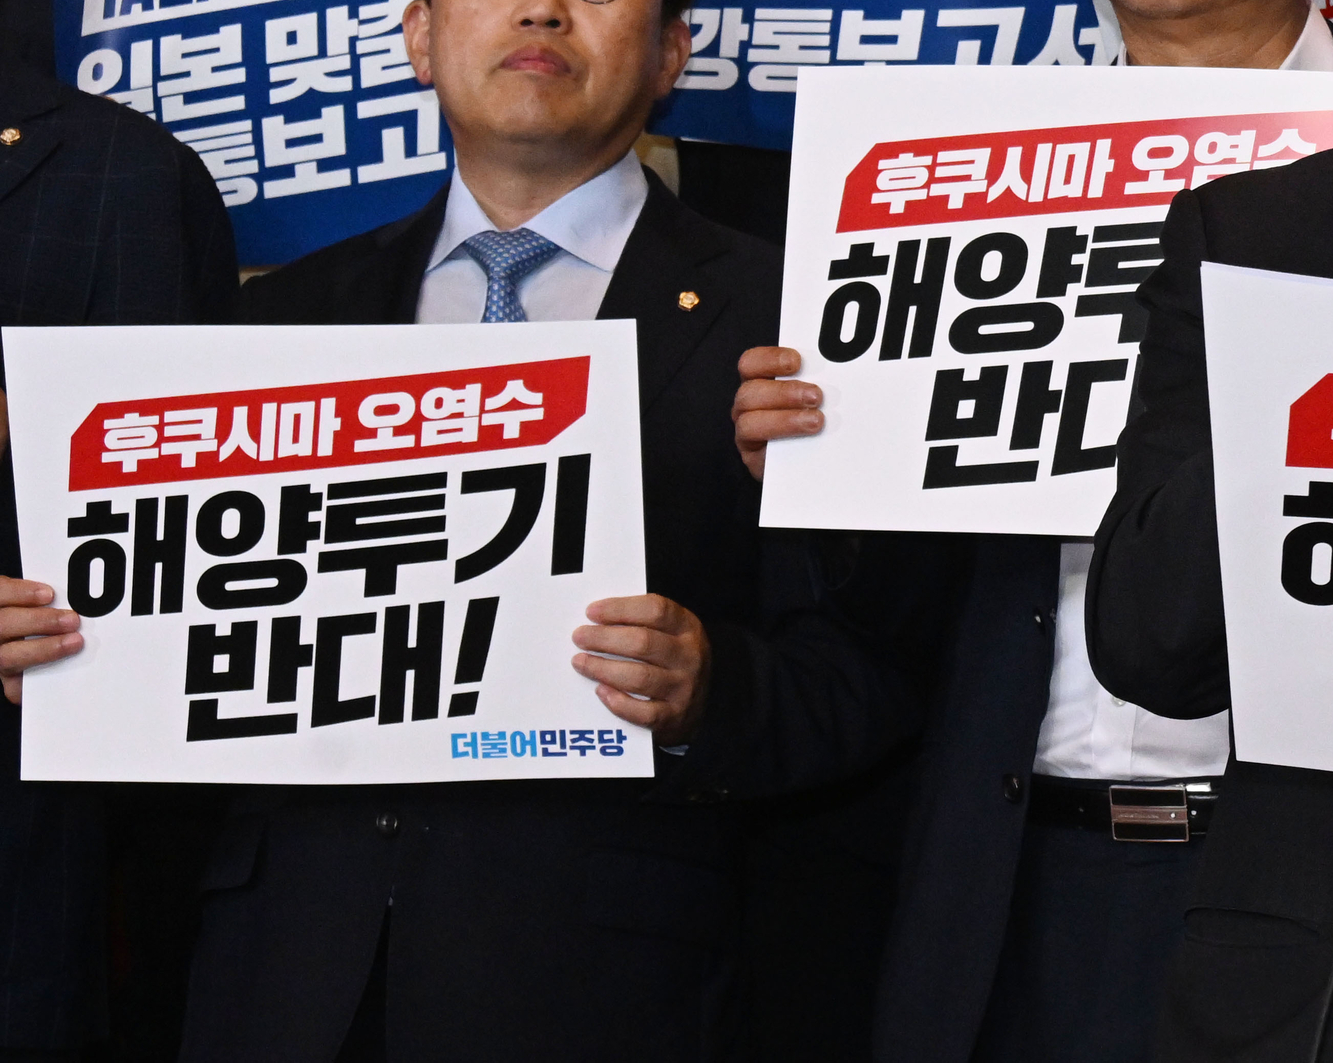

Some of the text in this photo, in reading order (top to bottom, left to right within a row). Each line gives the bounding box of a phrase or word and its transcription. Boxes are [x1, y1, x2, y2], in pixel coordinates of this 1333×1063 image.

[870, 140, 1114, 214] 후쿠시마
[101, 379, 544, 472] 후쿠시마 오염수
[66, 453, 592, 618] 해양투기
[185, 596, 500, 743] 반대!
[450, 729, 627, 760] 더불어민주당
